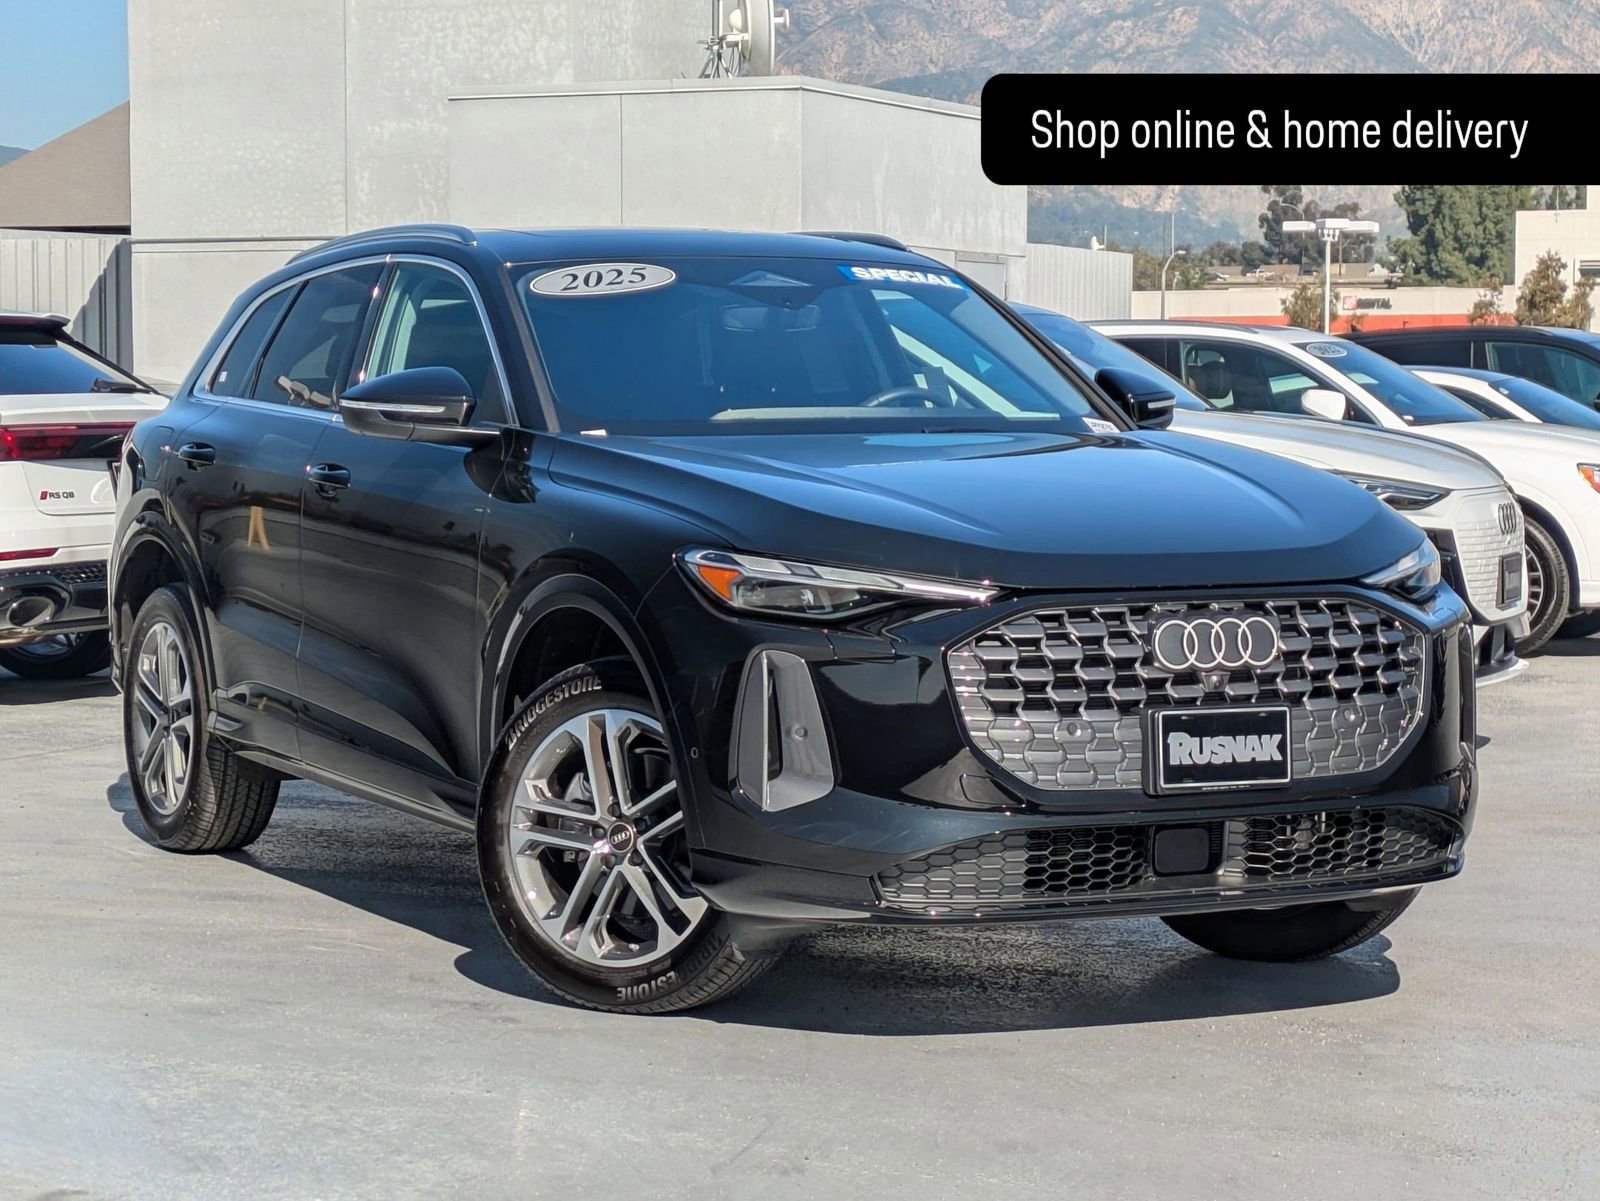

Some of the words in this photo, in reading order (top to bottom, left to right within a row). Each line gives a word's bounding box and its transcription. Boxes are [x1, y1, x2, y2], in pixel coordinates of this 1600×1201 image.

[560, 267, 646, 291] 2025
[850, 266, 963, 289] SPECIAL
[505, 675, 602, 751] BRIDGESTONE
[1168, 732, 1283, 765] RUSNAK
